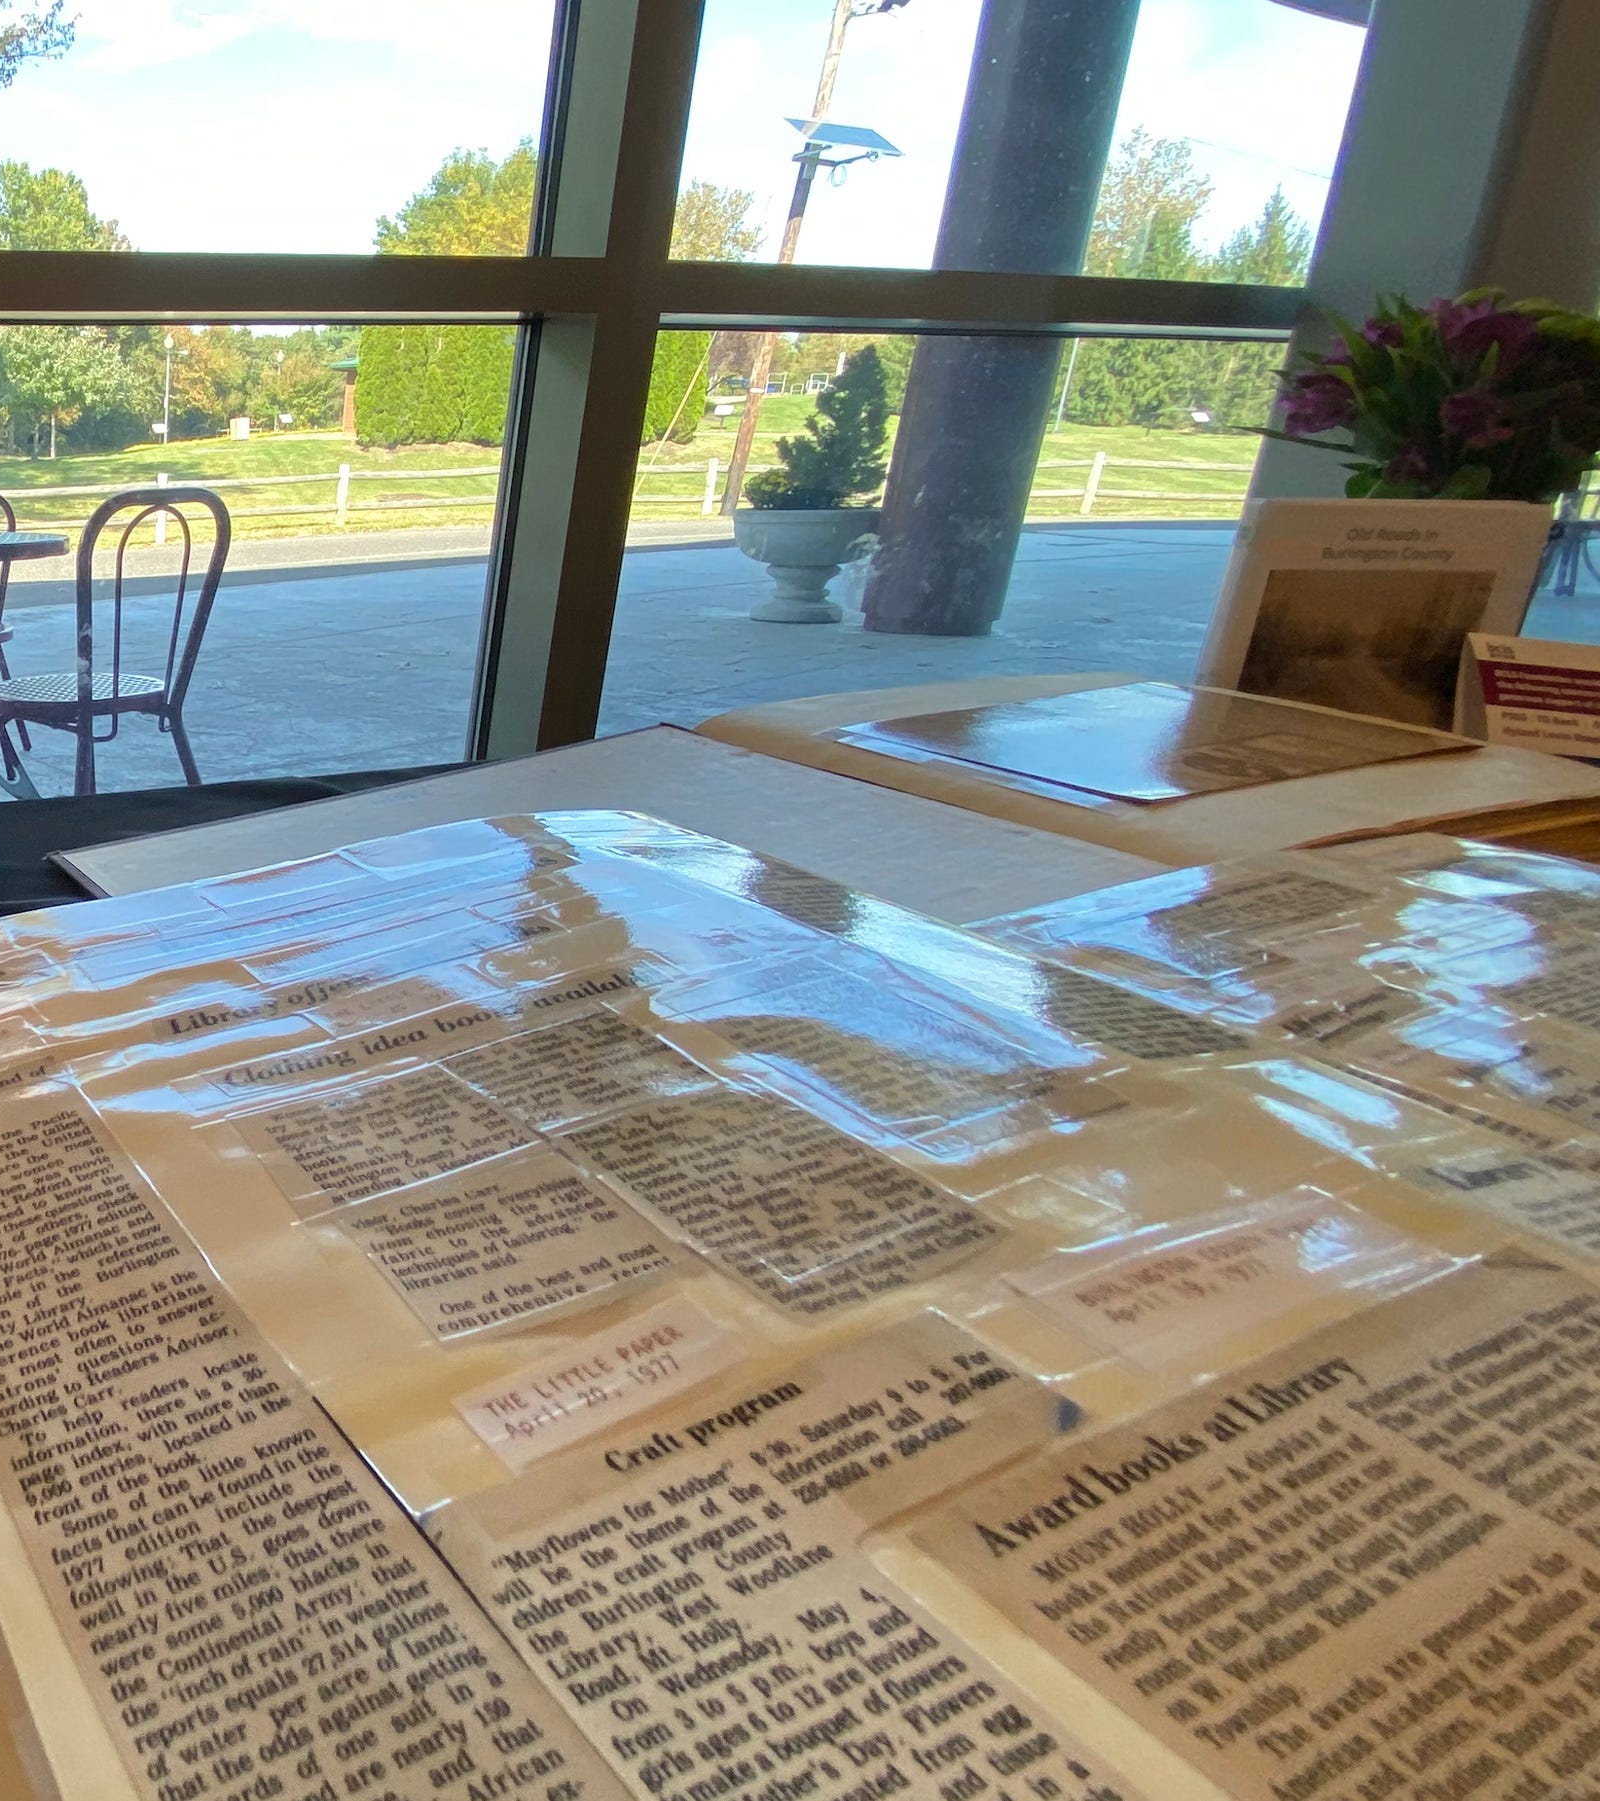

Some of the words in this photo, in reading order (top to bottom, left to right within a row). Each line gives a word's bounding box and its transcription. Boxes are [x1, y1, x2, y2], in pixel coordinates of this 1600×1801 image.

[1322, 546, 1398, 563] Burlington
[1401, 547, 1456, 562] County
[1345, 527, 1374, 542] Old
[167, 998, 279, 1034] Library
[223, 1041, 355, 1087] Clothing
[359, 1021, 427, 1055] idea
[29, 1064, 52, 1085] of
[18, 1316, 70, 1342] World
[77, 1288, 147, 1322] Almanac
[150, 1281, 167, 1293] is
[170, 1270, 198, 1286] the
[22, 1297, 85, 1325] Library.
[66, 1319, 110, 1342] book
[117, 1284, 206, 1322] librarians
[401, 1266, 477, 1291] librarian
[481, 1252, 521, 1271] said.
[439, 1299, 475, 1315] One
[481, 1289, 499, 1304] of
[503, 1283, 533, 1297] the
[535, 1270, 575, 1287] best
[579, 1256, 612, 1275] and
[617, 1243, 659, 1263] most
[482, 1392, 529, 1417] THE
[532, 1357, 613, 1399] LITTLE
[615, 1326, 683, 1363] PAPER
[496, 1393, 571, 1439] April
[626, 1353, 680, 1385] 1977
[799, 1400, 884, 1442] Saturday
[904, 1379, 930, 1394] to
[952, 1350, 991, 1370] For
[604, 1433, 683, 1472] Craft
[687, 1383, 802, 1446] program
[773, 1431, 878, 1484] information
[881, 1406, 923, 1432] call
[972, 1462, 1103, 1560] Award
[1095, 1432, 1208, 1508] books
[1204, 1408, 1244, 1445] at
[1229, 1356, 1368, 1427] Library
[33, 1497, 82, 1525] front
[91, 1484, 110, 1504] of
[116, 1473, 149, 1493] the
[153, 1452, 200, 1478] book.
[61, 1508, 117, 1537] Some
[128, 1491, 147, 1511] of
[157, 1479, 190, 1499] the
[198, 1456, 245, 1482] little
[253, 1428, 316, 1460] known
[61, 1556, 104, 1586] 1977
[124, 1522, 200, 1560] edition
[215, 1483, 292, 1522] include
[307, 1464, 342, 1483] the
[492, 1517, 621, 1571] "Mayflowers
[622, 1500, 655, 1522] for
[659, 1461, 733, 1505] Mother"
[492, 1578, 533, 1605] will
[540, 1561, 571, 1585] be
[580, 1547, 617, 1569] the
[625, 1516, 689, 1549] theme
[699, 1497, 722, 1518] of
[728, 1483, 764, 1504] the
[613, 1554, 665, 1585] craft
[671, 1516, 756, 1564] program
[762, 1500, 787, 1520] at
[1033, 1528, 1122, 1582] MOUNT
[1120, 1487, 1202, 1538] HOLLY
[528, 1629, 568, 1654] the
[581, 1572, 703, 1631] Burlington
[714, 1531, 791, 1571] County
[547, 1631, 652, 1679] Library,
[659, 1594, 719, 1627] West
[727, 1545, 832, 1595] Woodlane
[568, 1665, 639, 1705] Road,
[637, 1647, 675, 1673] Mt.
[680, 1618, 749, 1652] Holly.
[610, 1697, 649, 1721] On
[659, 1636, 791, 1695] Wednesday,
[796, 1603, 849, 1633] May
[858, 1586, 894, 1607] 4,
[611, 1723, 673, 1759] from
[673, 1708, 696, 1730] 3
[696, 1698, 725, 1719] to
[725, 1683, 748, 1705] 5
[808, 1631, 865, 1662] boys
[868, 1605, 913, 1637] and
[639, 1751, 693, 1790] girls
[695, 1724, 750, 1760] ages
[747, 1711, 768, 1732] 6
[765, 1702, 795, 1723] to
[793, 1684, 825, 1709] 12
[824, 1668, 866, 1698] are
[864, 1628, 938, 1677] invited
